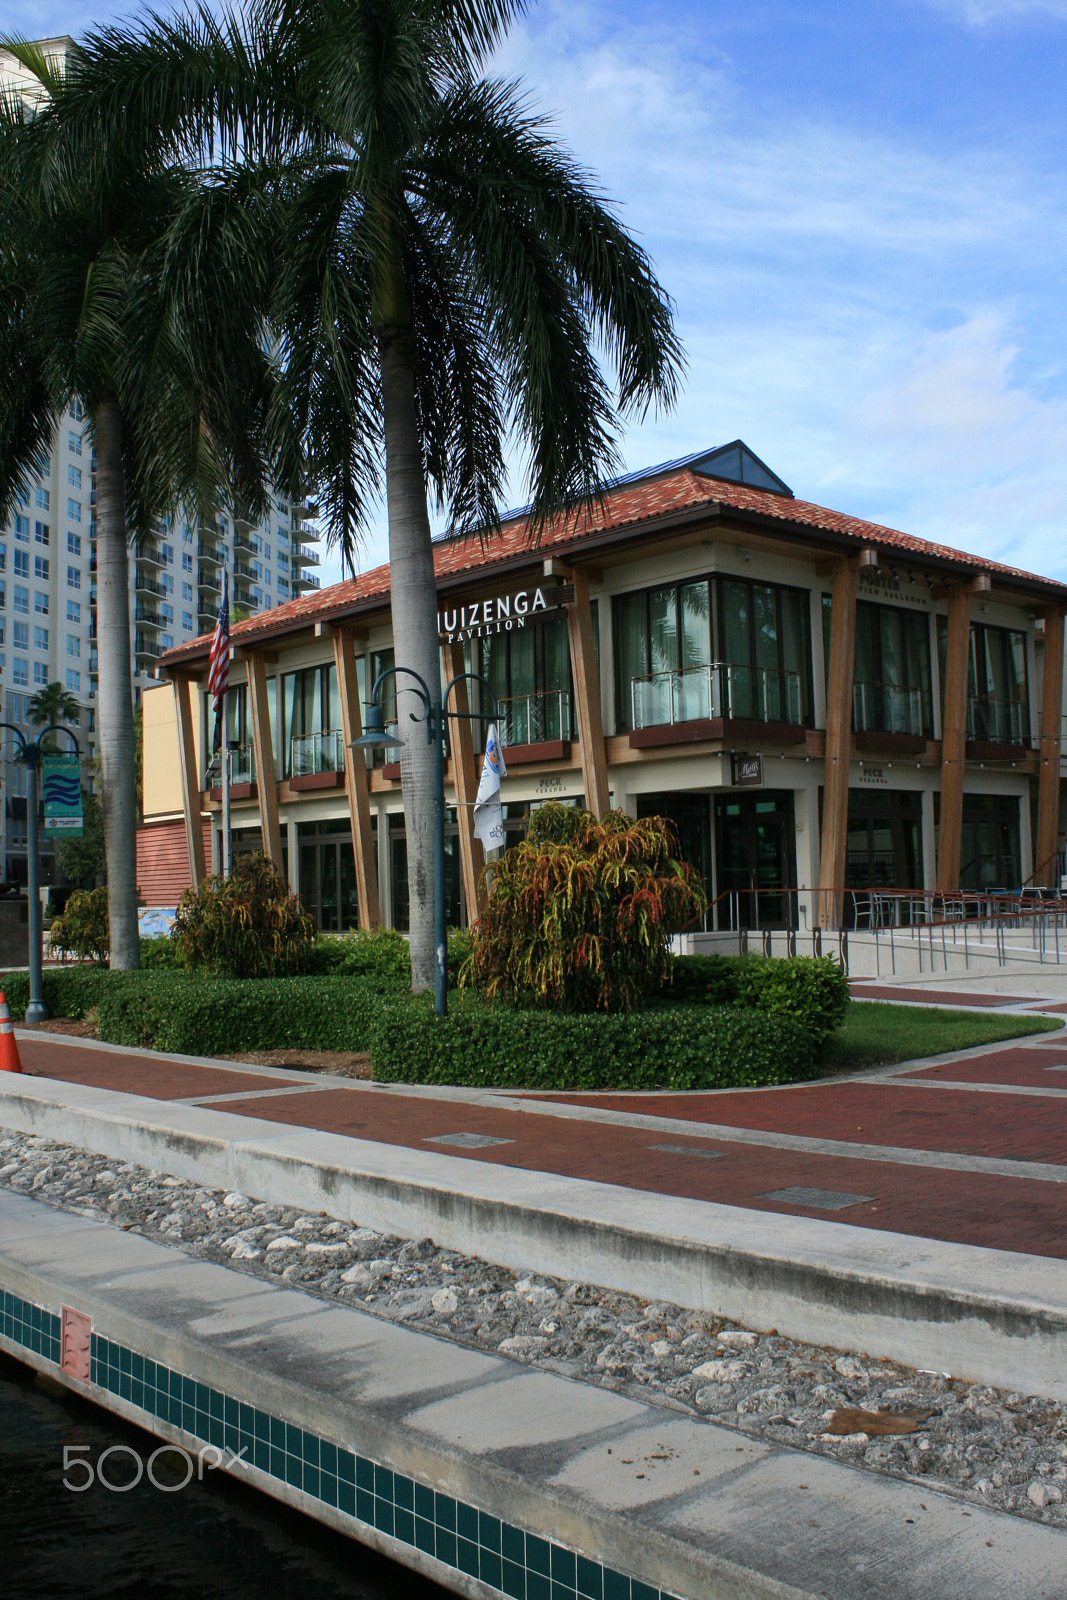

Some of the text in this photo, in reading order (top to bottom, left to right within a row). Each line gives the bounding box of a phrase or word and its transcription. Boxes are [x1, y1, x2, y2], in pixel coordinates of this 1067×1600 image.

[448, 616, 525, 643] PAVILION
[863, 768, 883, 777] PECK
[539, 777, 562, 787] PECK
